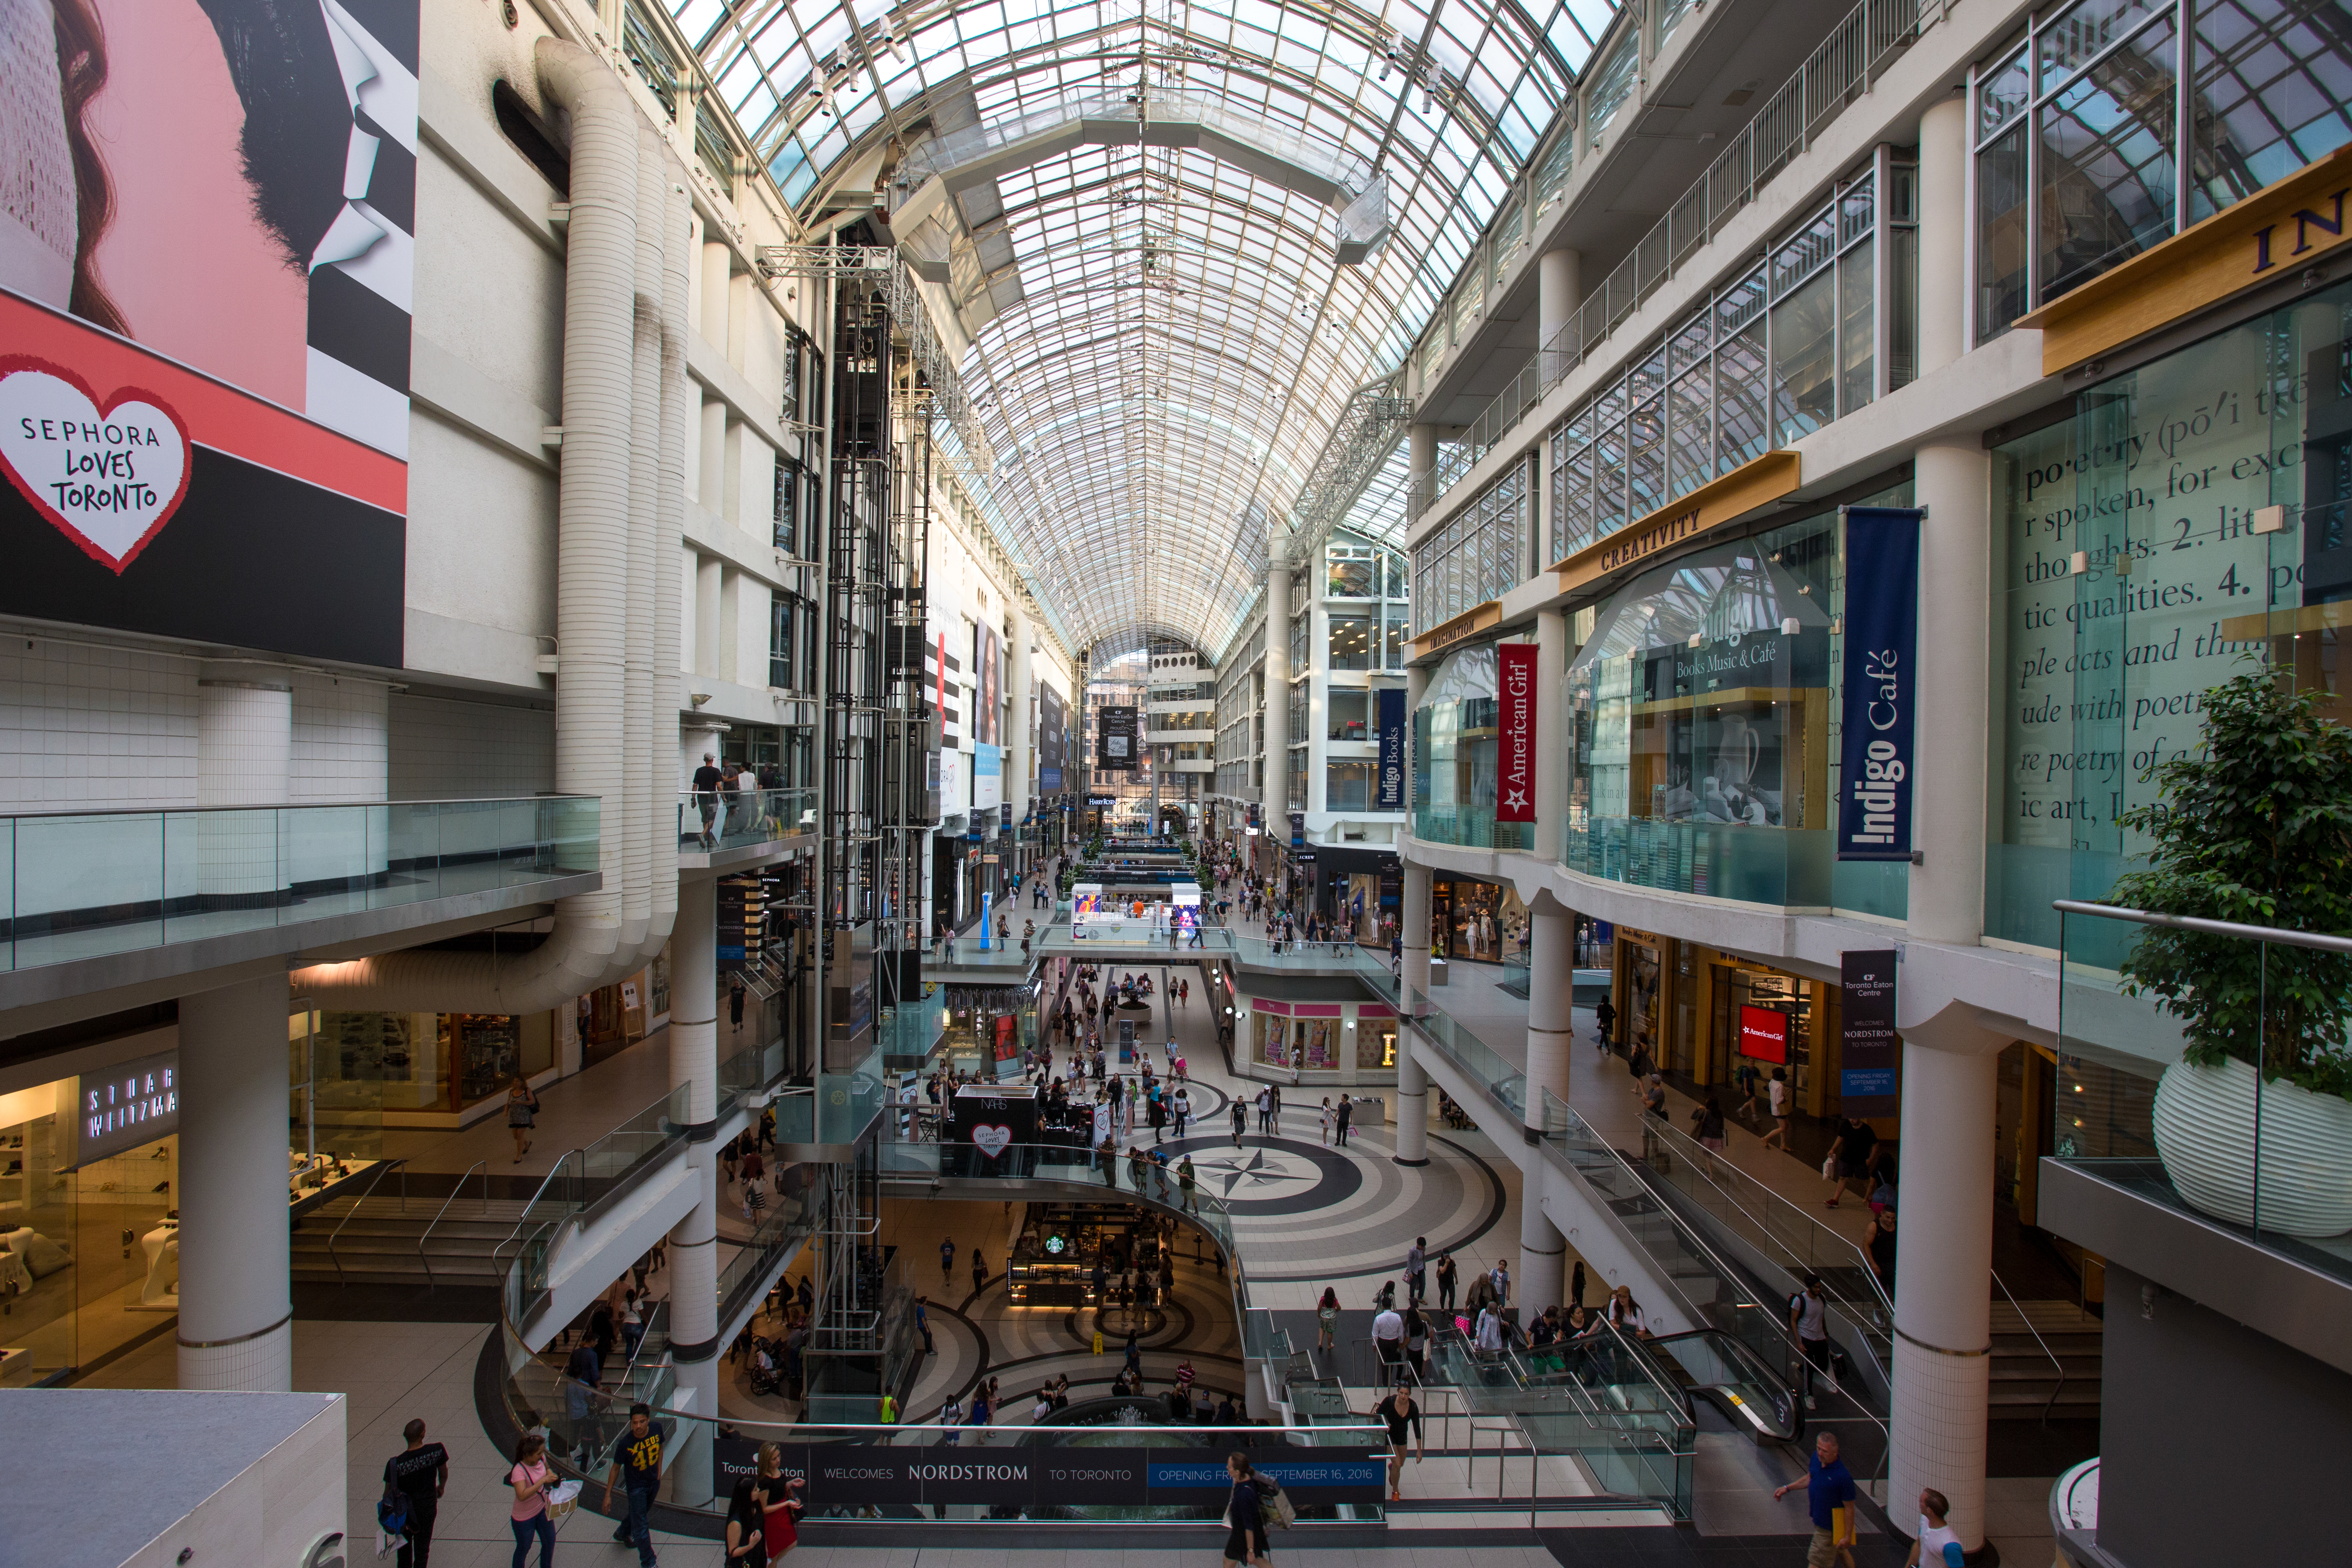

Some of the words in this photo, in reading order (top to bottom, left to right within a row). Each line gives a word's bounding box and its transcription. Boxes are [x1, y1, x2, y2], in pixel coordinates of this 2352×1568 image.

[21, 418, 159, 447] SEPHORA
[66, 450, 135, 479] LOVES
[50, 482, 157, 513] TORONTO
[2044, 487, 2155, 542] spoken,
[2166, 462, 2217, 499] for
[1600, 508, 1701, 571] CREATIVITY
[2025, 534, 2157, 584] thoghts.
[2172, 518, 2203, 552] 2.
[2025, 605, 2056, 630] tic
[2066, 580, 2202, 634] qualities.
[2218, 562, 2251, 597] 4.
[1430, 619, 1475, 650] IMAGINATION
[1678, 658, 1705, 678] Books
[1708, 651, 1737, 673] Music
[1740, 653, 1750, 668] &
[1751, 642, 1775, 664] Café
[2021, 647, 2057, 689] ple
[2065, 646, 2113, 672] acts
[2124, 628, 2181, 666] and
[1866, 649, 1898, 731] Café
[1477, 706, 1488, 716] Books
[2021, 694, 2061, 725] ude
[2070, 688, 2123, 722] with
[2132, 690, 2214, 732] poetr
[1386, 727, 1399, 763] Books
[1507, 698, 1527, 786] American
[2020, 752, 2040, 771] re
[2046, 750, 2123, 784] poetry
[2132, 736, 2167, 784] of
[1382, 768, 1400, 802] Indigo
[1852, 741, 1905, 843] Indigo
[2020, 791, 2041, 819] ic
[2050, 797, 2098, 828] art,
[1750, 1029, 1773, 1039] American
[89, 1069, 172, 1111] STUAR
[982, 1098, 1007, 1110] NARS
[89, 1092, 177, 1137] WEITZMA
[979, 1130, 1005, 1139] SEPHORA
[1776, 1397, 1788, 1412] Level
[1779, 1408, 1784, 1423] 3
[722, 1462, 758, 1476] Toront
[824, 1468, 894, 1479] WELCOMES
[909, 1464, 1028, 1480] NORDSTROM
[1049, 1470, 1066, 1480] TO
[1070, 1470, 1131, 1480] TORONTO
[1159, 1470, 1212, 1481] OPENING
[1262, 1469, 1327, 1480] SEPTEMBER
[1331, 1469, 1344, 1480] 16,
[1348, 1469, 1372, 1480] 2016
